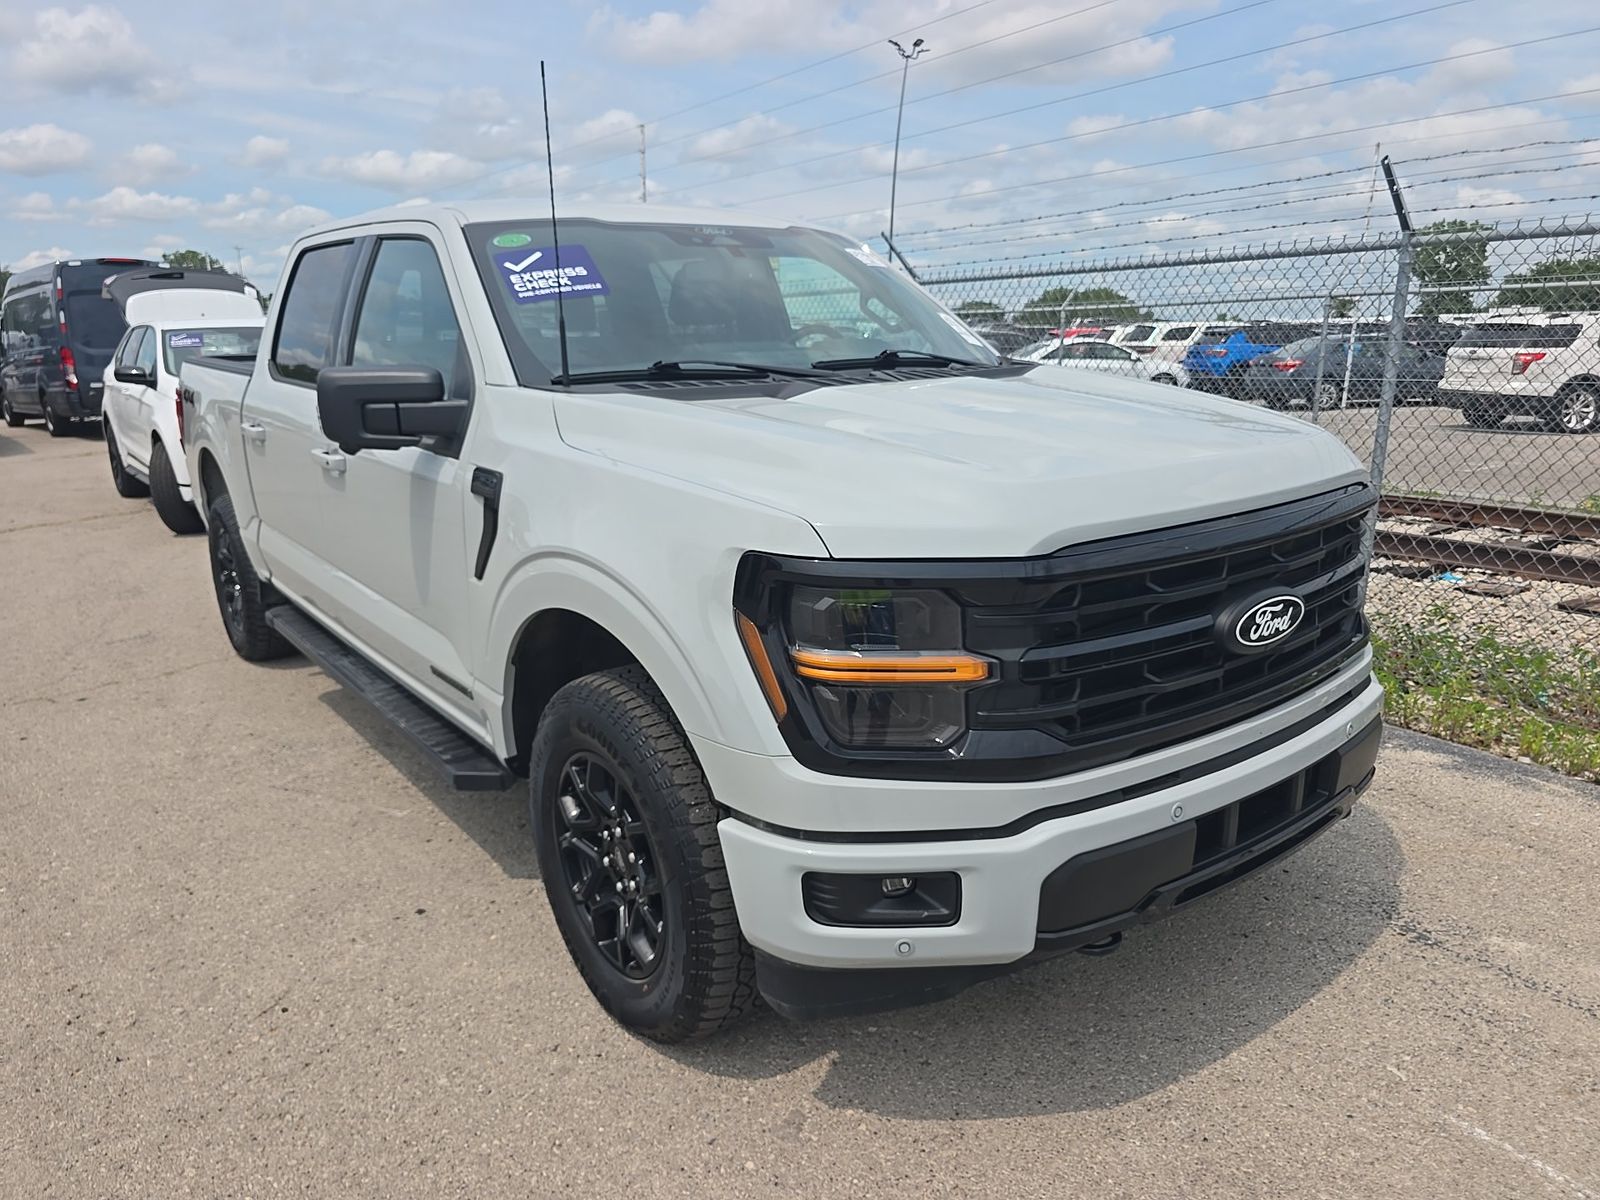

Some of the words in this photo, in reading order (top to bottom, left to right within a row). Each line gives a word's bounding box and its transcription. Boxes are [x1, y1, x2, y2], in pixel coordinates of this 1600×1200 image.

[509, 266, 588, 284] EXPRESS
[513, 275, 572, 292] CHECK
[517, 285, 573, 299] PRE-CERTIFED
[1250, 603, 1294, 641] Ford
